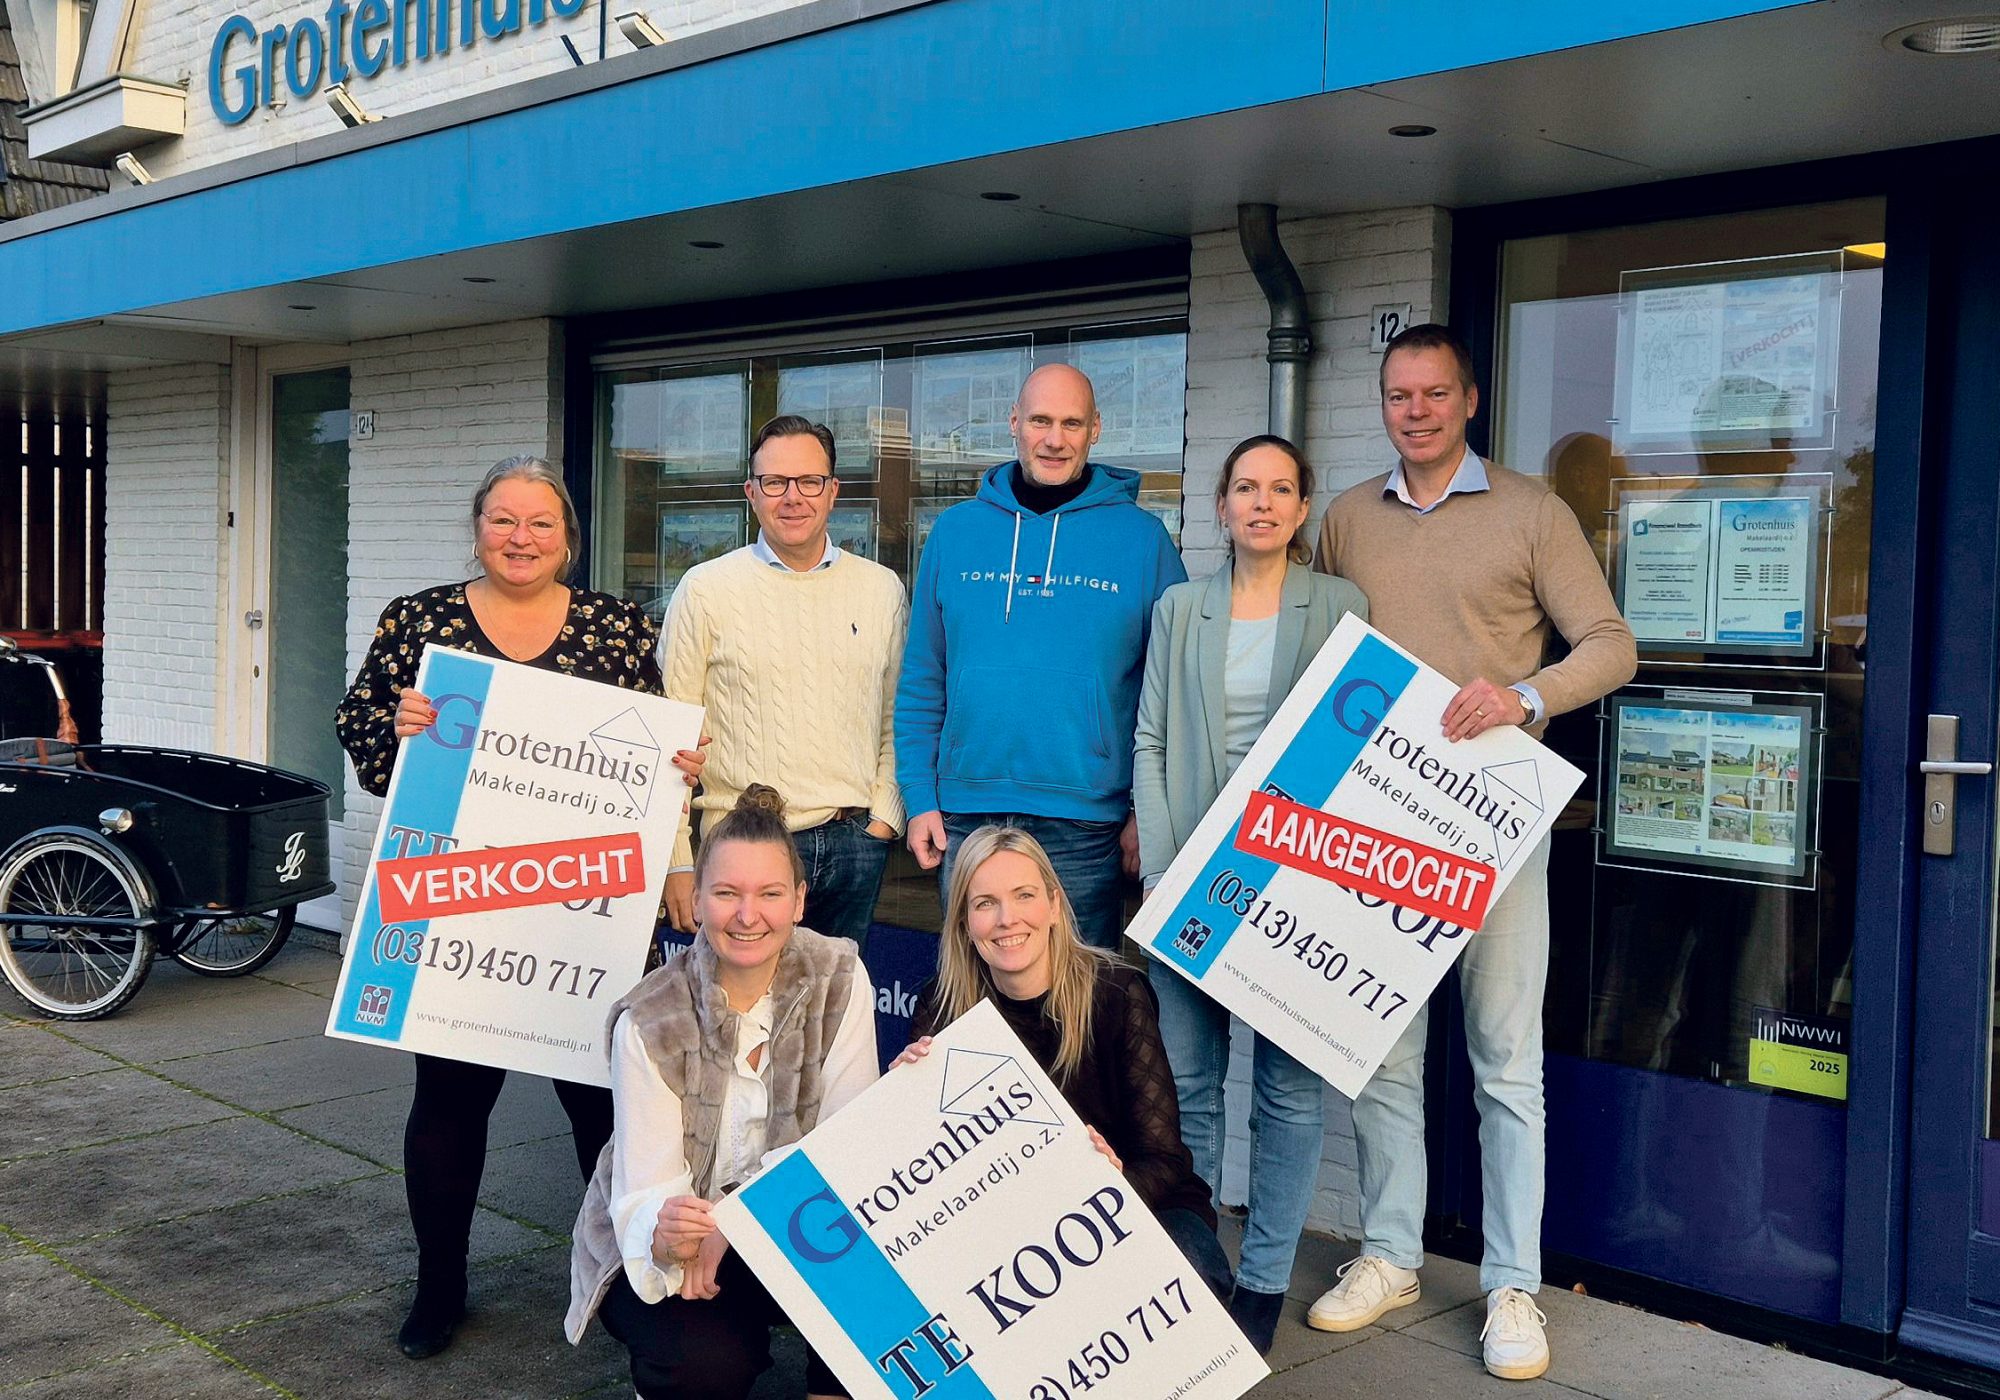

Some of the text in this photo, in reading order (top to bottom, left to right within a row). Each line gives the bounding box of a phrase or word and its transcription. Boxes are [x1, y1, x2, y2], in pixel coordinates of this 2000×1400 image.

[208, 0, 586, 126] Groten
[1380, 312, 1400, 343] 12
[1732, 514, 1796, 532] Grotenhuis
[960, 571, 1119, 593] TOMMY HILFIGER
[424, 693, 649, 787] Grotenhuis
[1332, 678, 1526, 840] Grotenhuis
[468, 768, 639, 821] Makelaardij o.z.
[1352, 758, 1466, 847] Makelaardij
[391, 848, 634, 907] VERKOCHT
[1248, 803, 1487, 912] AANGEKOCHT
[1173, 939, 1197, 959] NVM
[548, 959, 607, 999] 717
[1348, 967, 1409, 1021] 717
[356, 1013, 386, 1025] NVM
[416, 1011, 592, 1053] www.grotenhuismakelaardij.nl
[1223, 960, 1368, 1070] www.grotenhuismakelaardij.nl
[1781, 1021, 1841, 1045] NWWI
[1809, 1059, 1840, 1075] 2025
[787, 1081, 1034, 1264] Grotenhuis
[884, 1128, 1062, 1262] Makelaardij o.z.
[877, 1186, 1133, 1400] TE KOOP
[1126, 1277, 1193, 1344] 717
